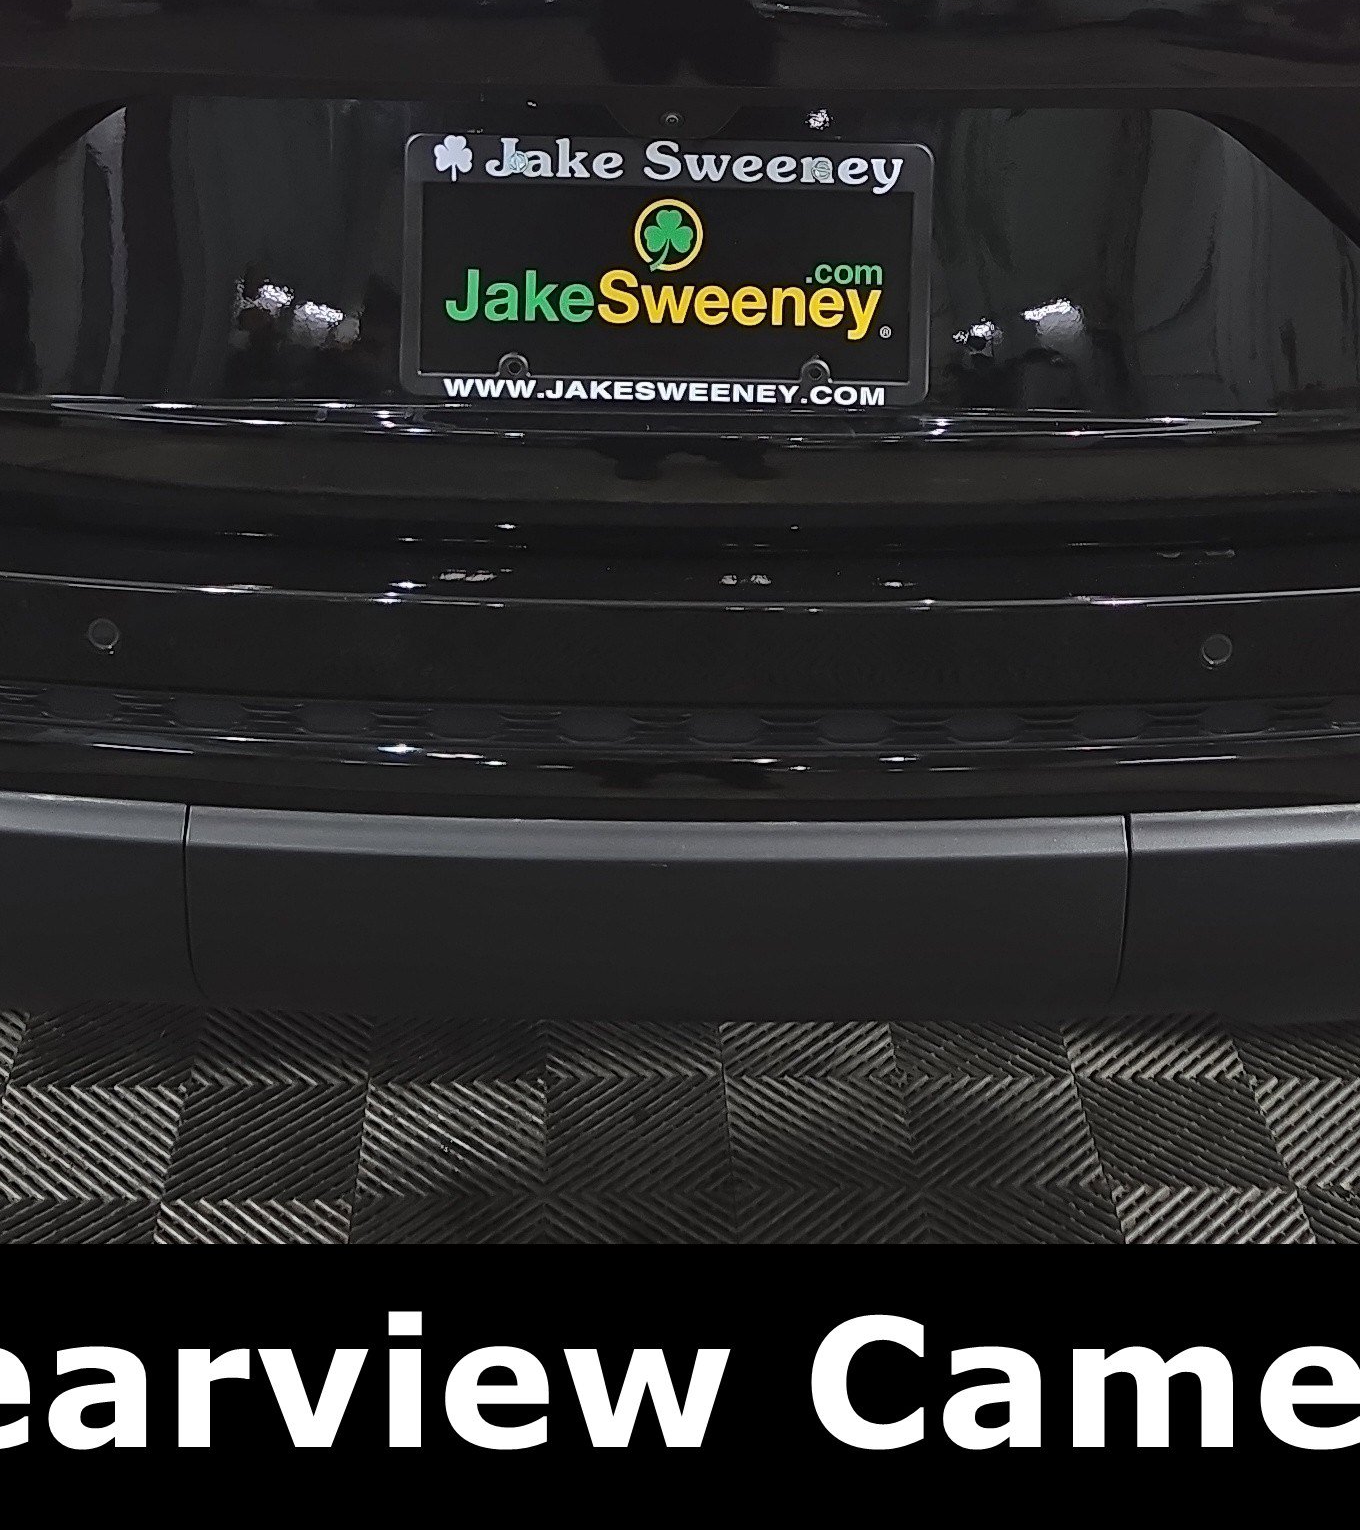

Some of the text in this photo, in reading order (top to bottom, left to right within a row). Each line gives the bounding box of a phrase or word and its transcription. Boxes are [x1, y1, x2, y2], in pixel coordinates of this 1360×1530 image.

[485, 137, 905, 195] Jake Sweeney
[443, 378, 886, 407] WWW.JAKESWEENEY.COM
